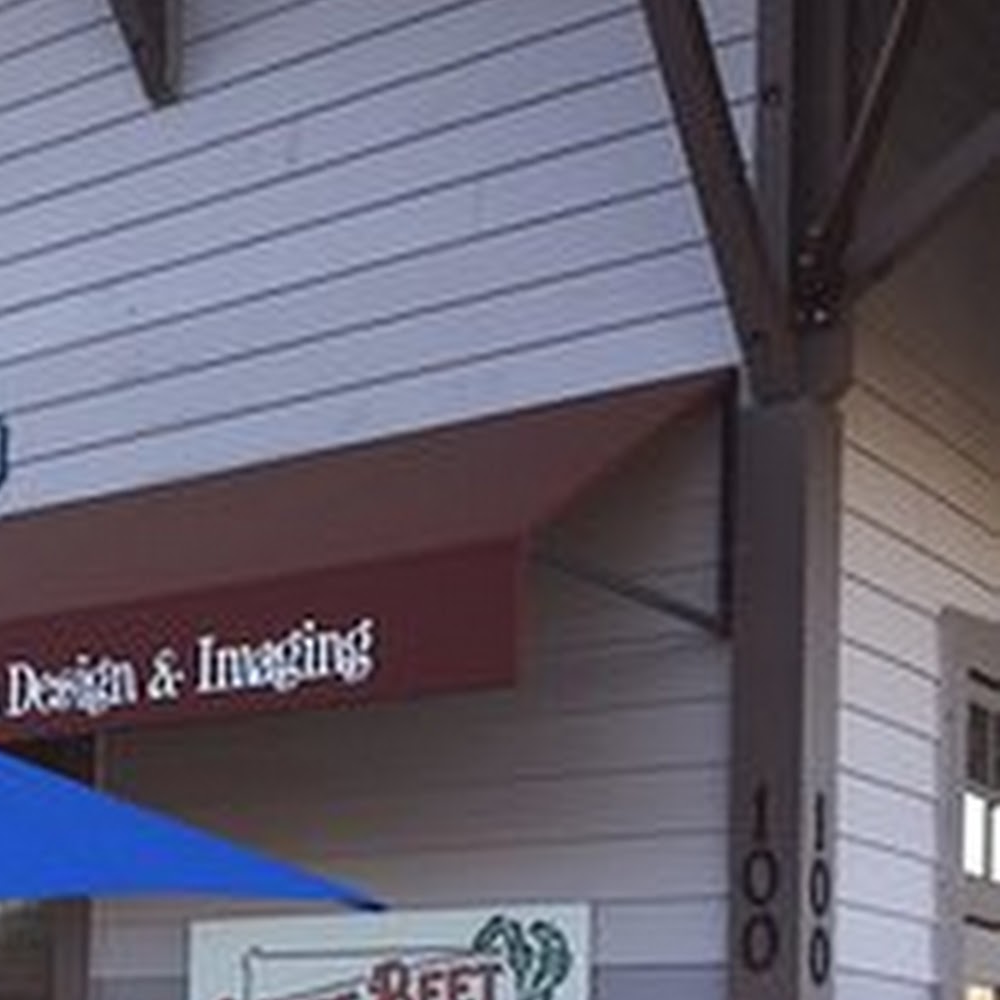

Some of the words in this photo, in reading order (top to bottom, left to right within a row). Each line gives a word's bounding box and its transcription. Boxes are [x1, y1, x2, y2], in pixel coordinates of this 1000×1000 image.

[6, 654, 137, 716] Design
[146, 648, 184, 700] &
[198, 618, 374, 694] Imaging
[743, 782, 779, 974] 100
[808, 790, 832, 988] 100
